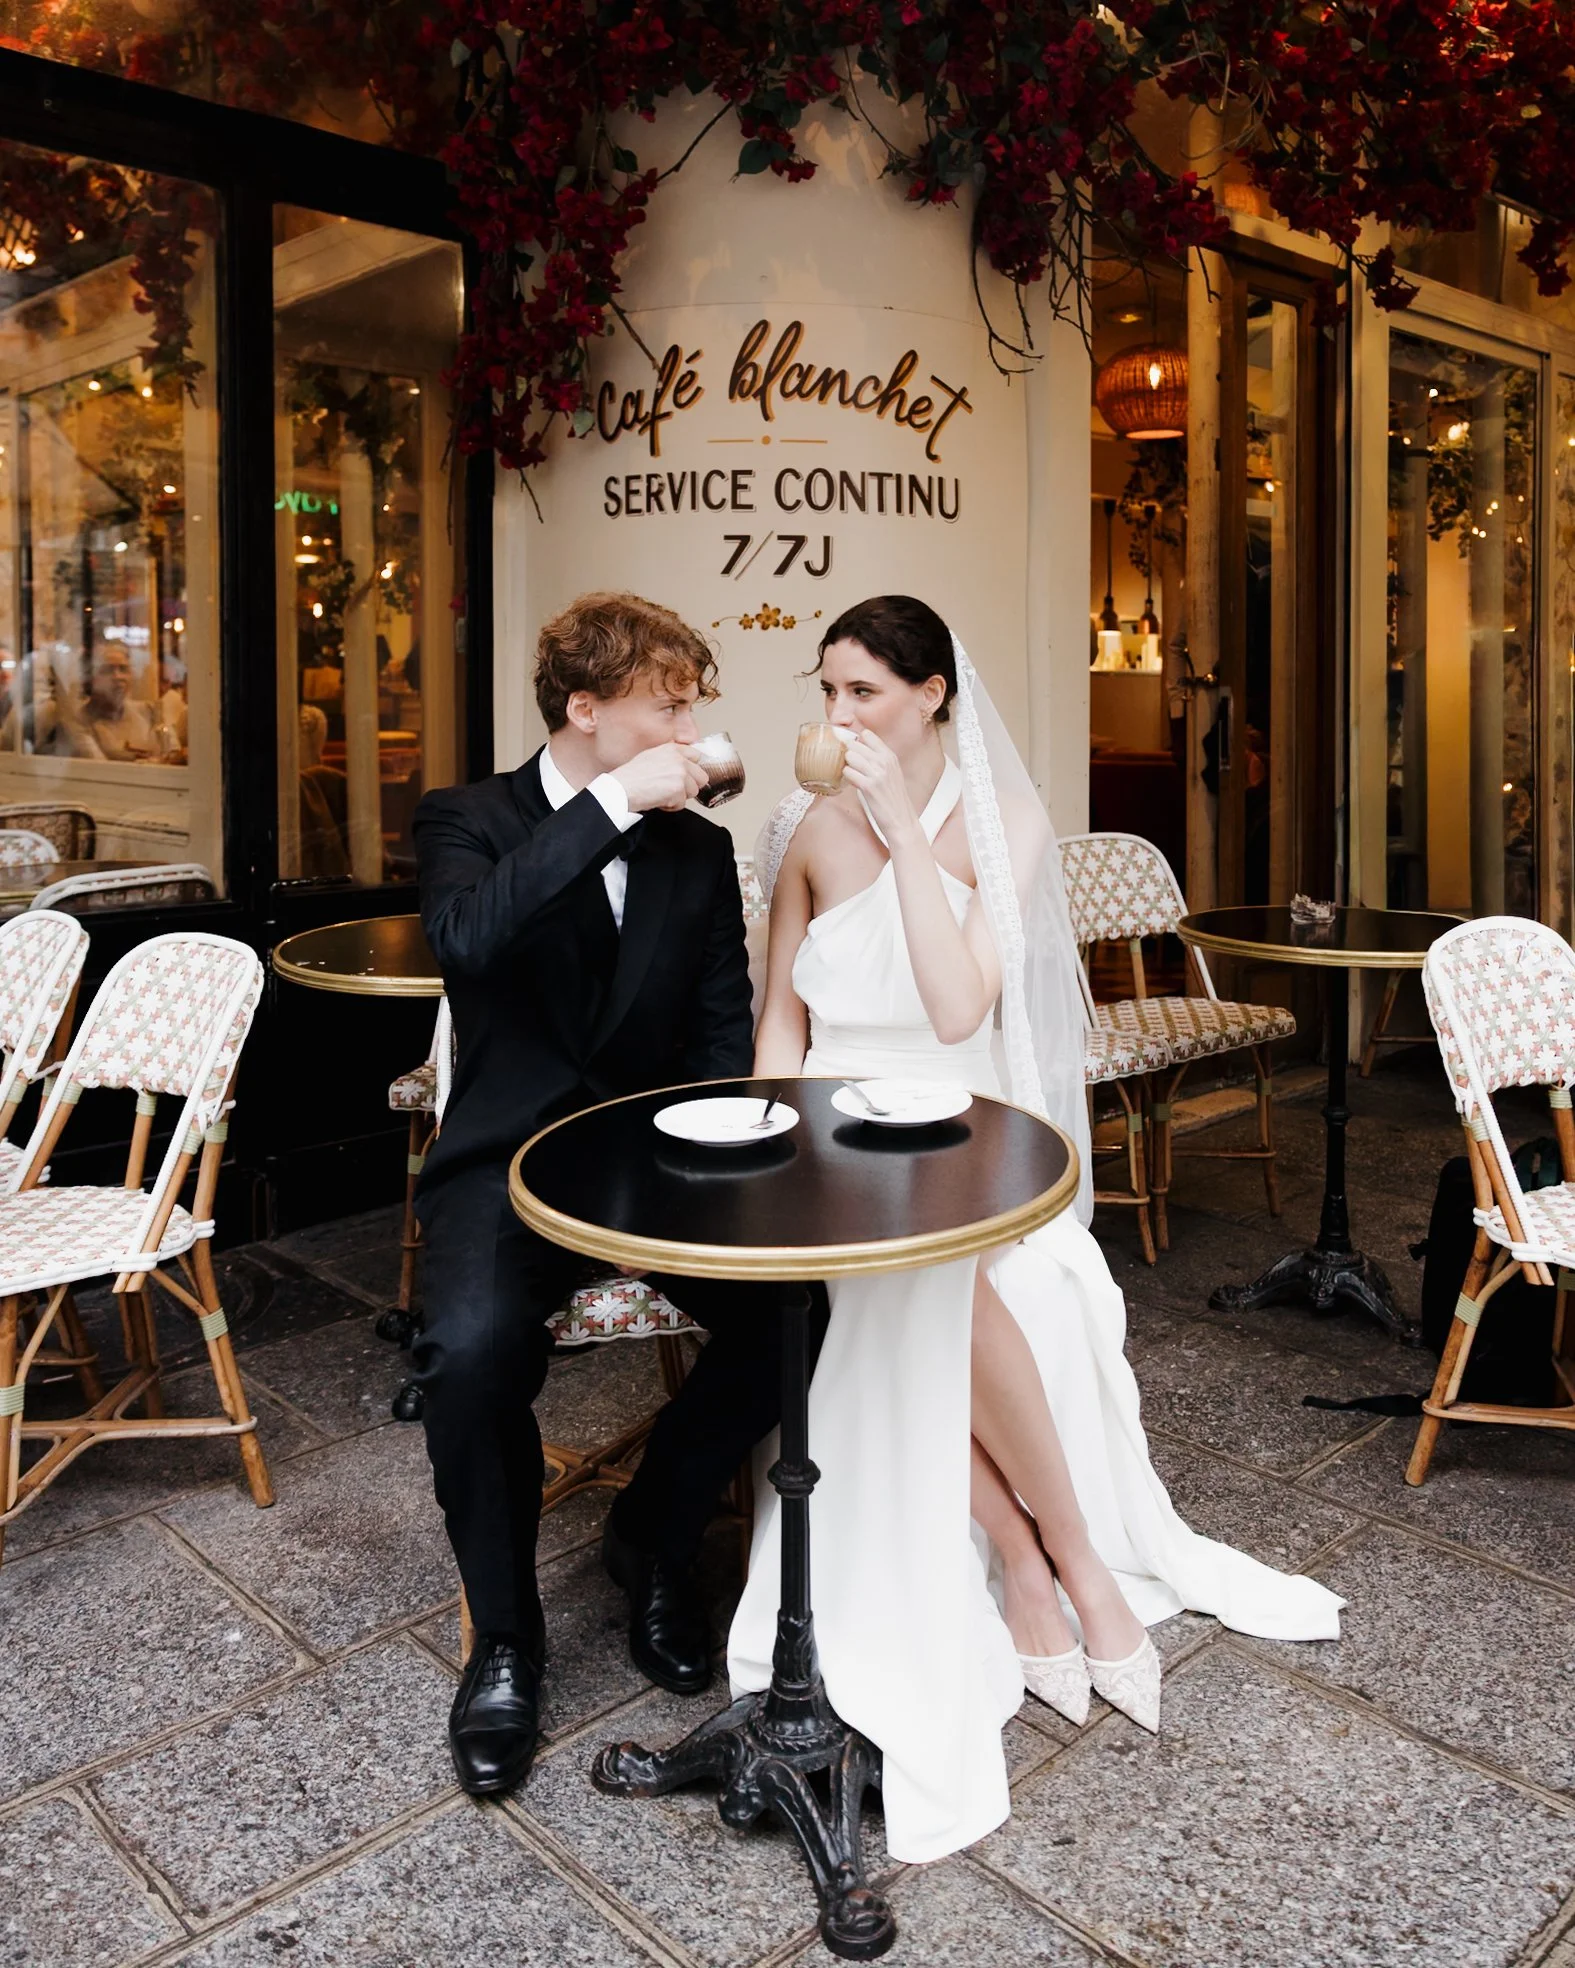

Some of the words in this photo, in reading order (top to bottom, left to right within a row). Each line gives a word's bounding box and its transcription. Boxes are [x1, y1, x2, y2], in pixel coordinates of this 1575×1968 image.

[597, 344, 705, 458] Café
[729, 319, 973, 463] blanchet
[604, 468, 756, 519] SERVICE
[774, 467, 961, 523] CONTINU
[720, 530, 833, 580] 7/7J
